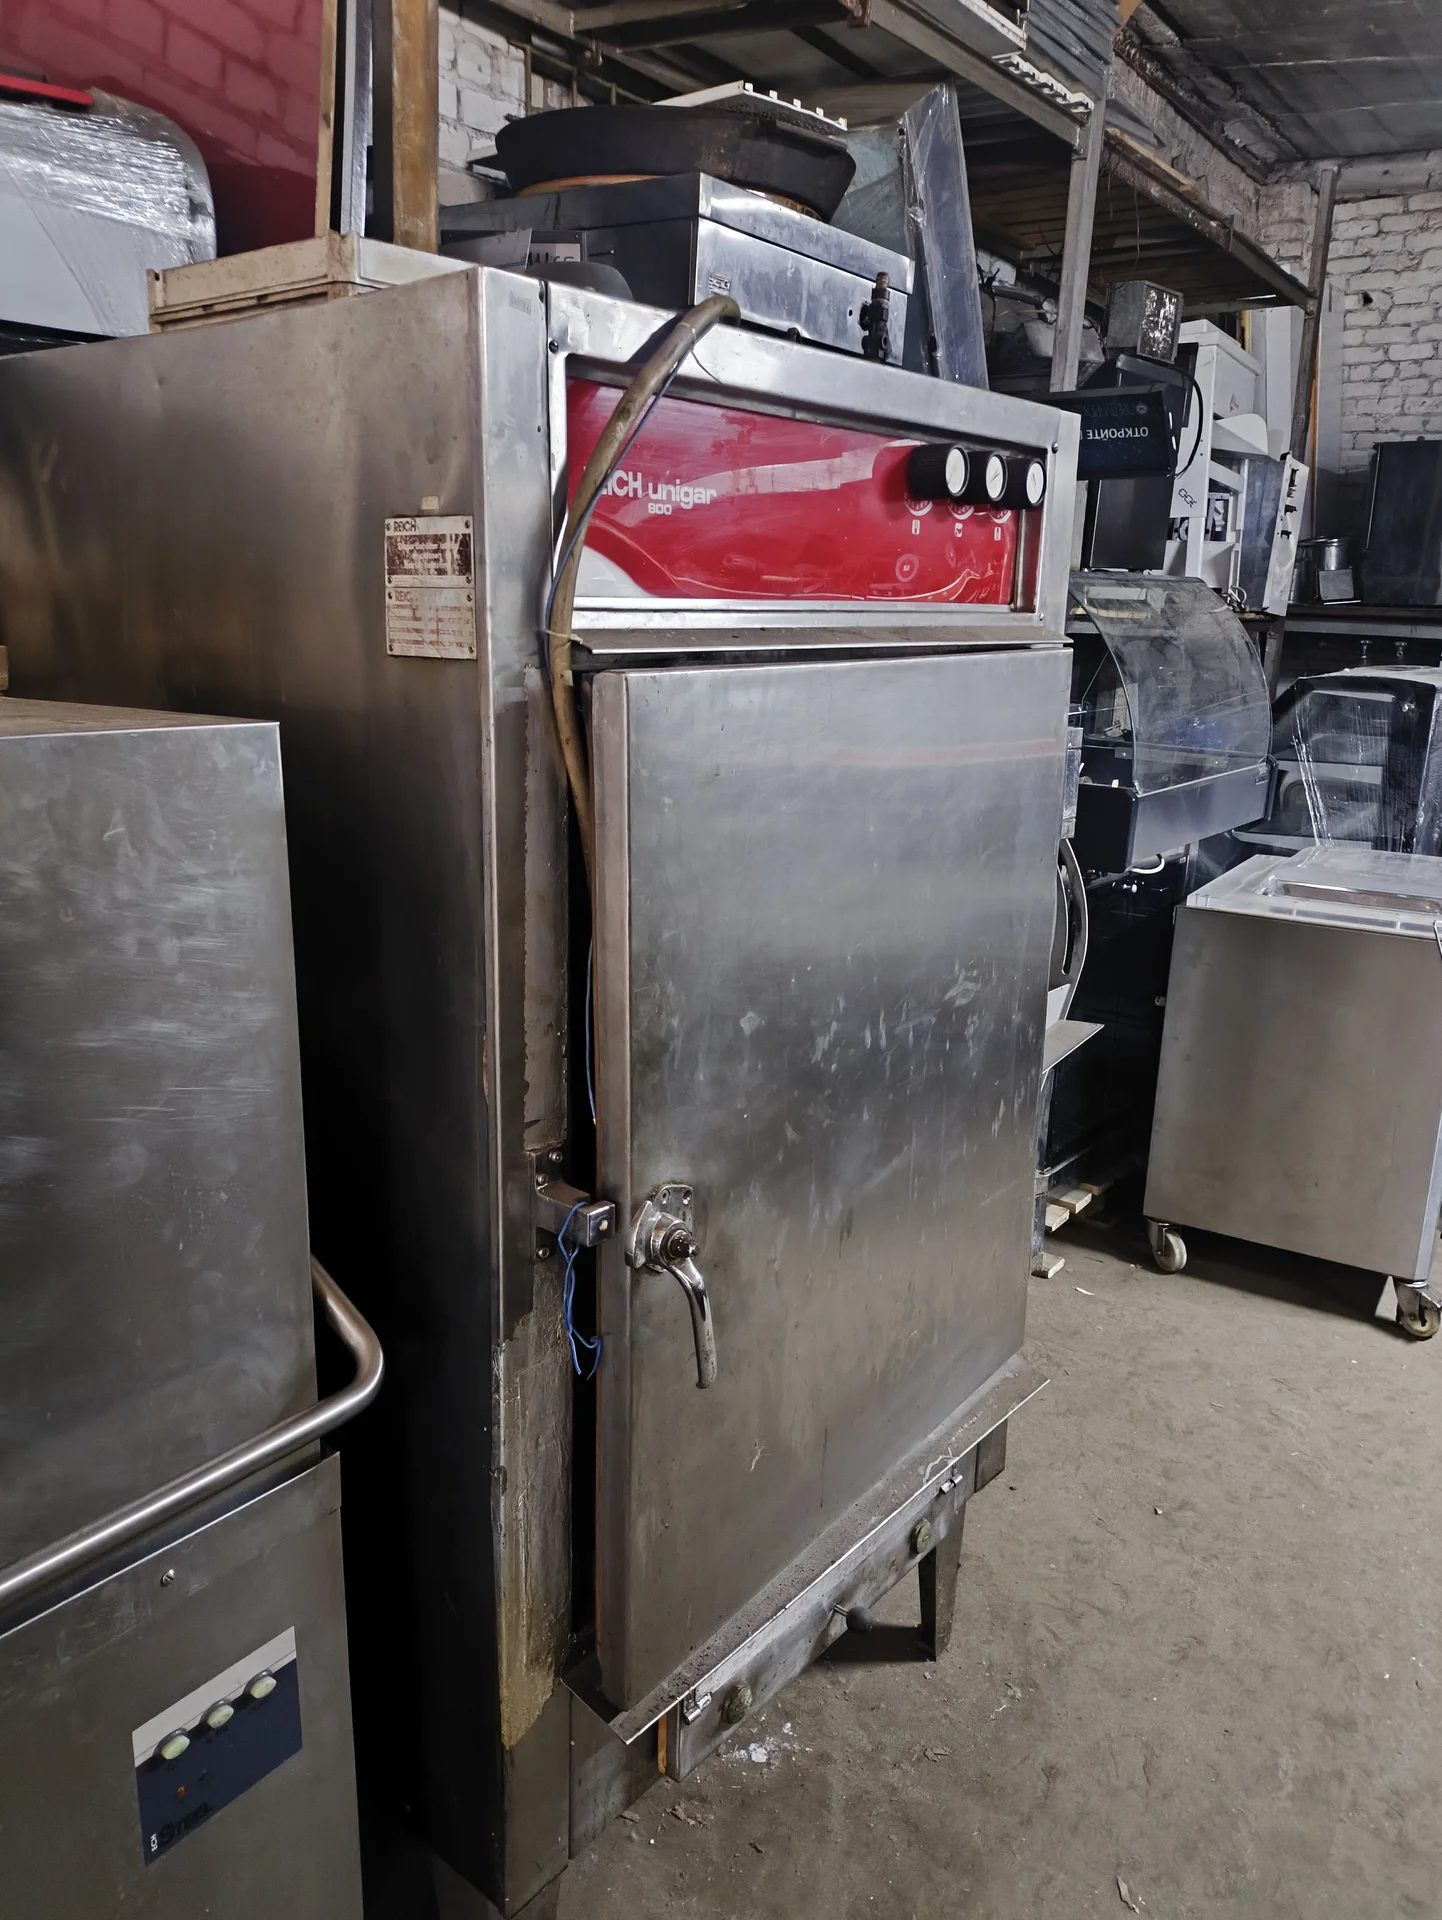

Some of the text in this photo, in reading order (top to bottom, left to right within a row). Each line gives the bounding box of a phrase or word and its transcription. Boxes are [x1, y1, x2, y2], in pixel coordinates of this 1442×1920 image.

[1086, 427, 1149, 441] ОТКРОЙТЕ
[599, 469, 717, 510] ICH unigar
[648, 502, 672, 515] 900
